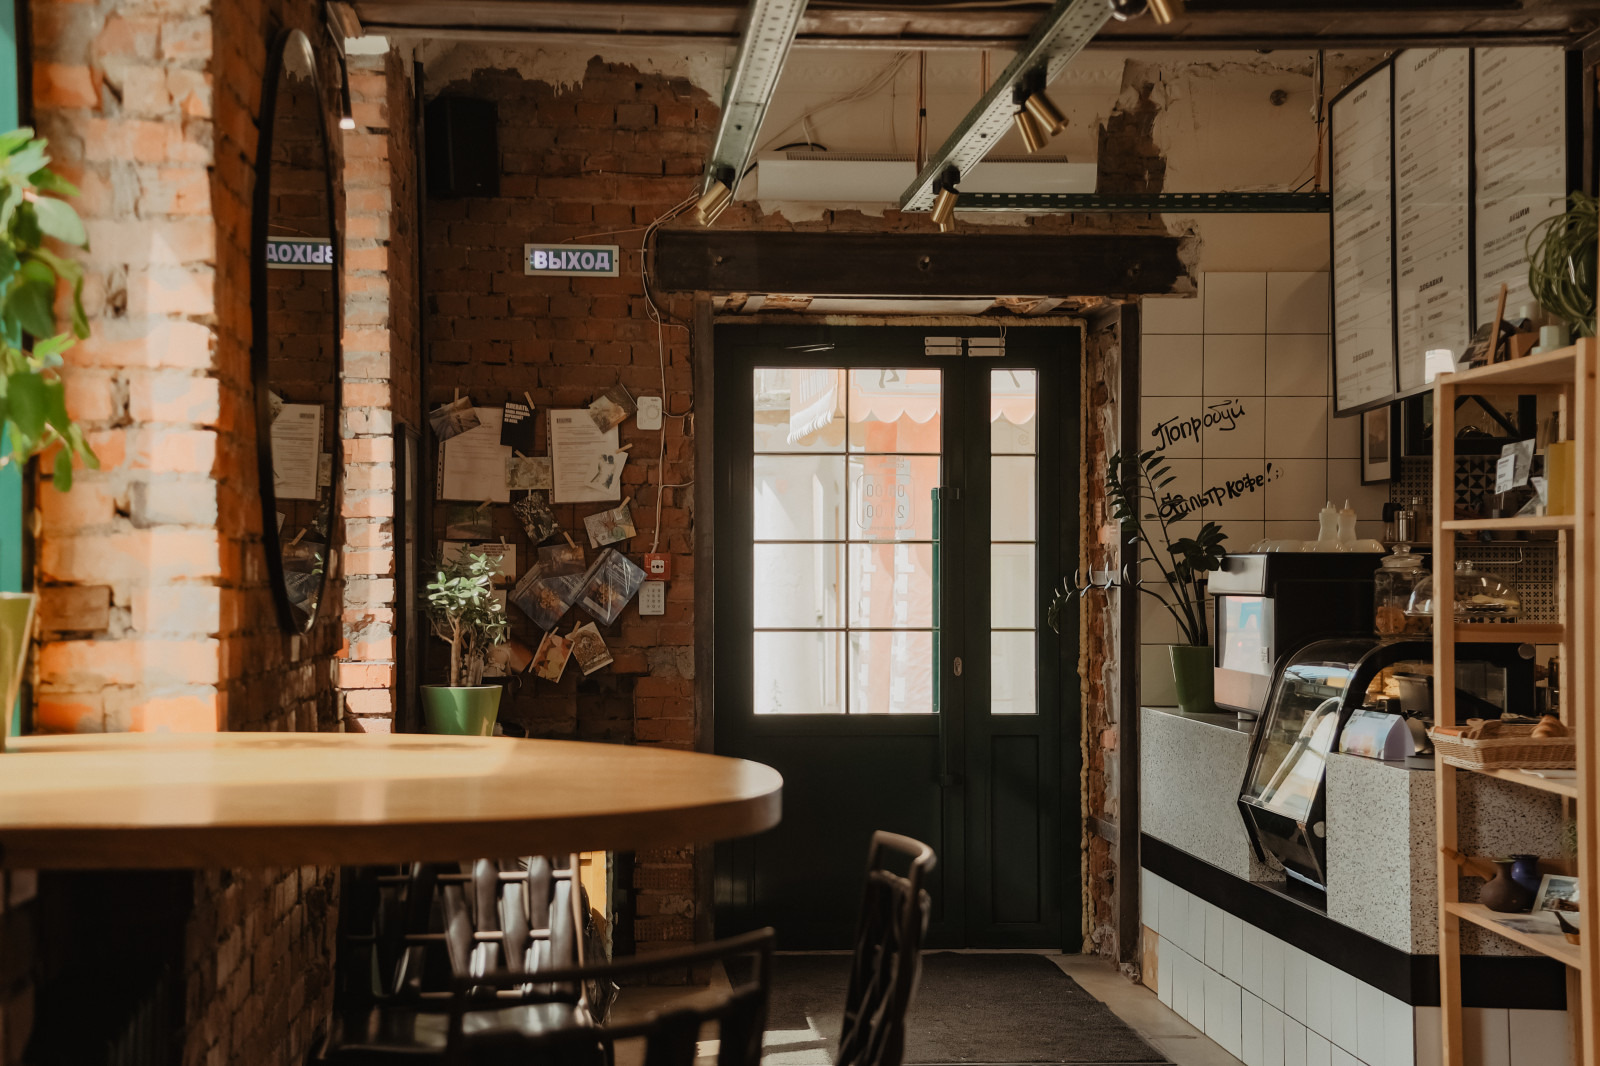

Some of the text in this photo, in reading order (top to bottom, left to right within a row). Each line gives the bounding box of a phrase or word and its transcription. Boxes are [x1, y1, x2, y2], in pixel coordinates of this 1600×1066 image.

[1414, 56, 1428, 72] LAZY
[534, 250, 610, 271] ВЫХОД
[1151, 399, 1246, 452] Попробуй
